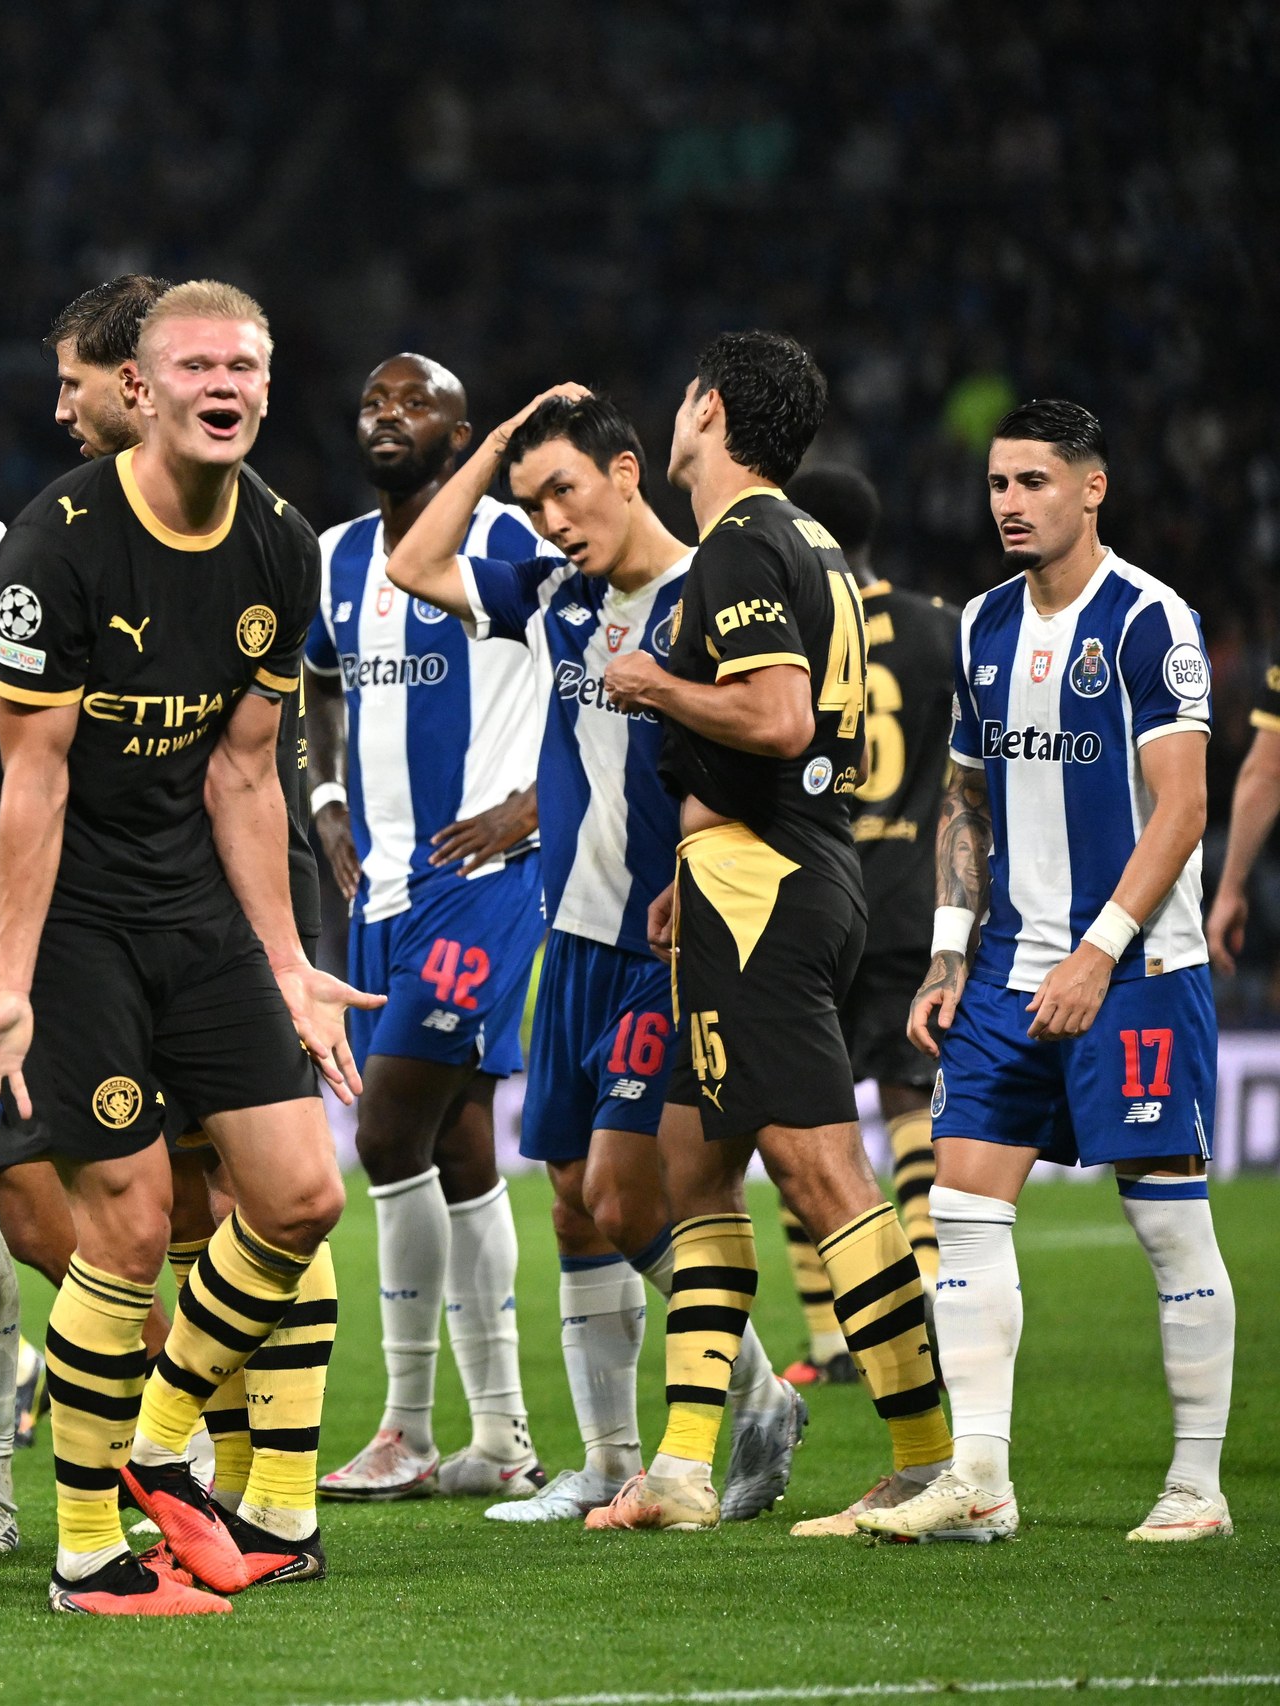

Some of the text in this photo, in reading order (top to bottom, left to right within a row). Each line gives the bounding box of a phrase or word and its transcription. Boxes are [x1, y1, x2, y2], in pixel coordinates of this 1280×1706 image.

[339, 653, 449, 692] Betano
[1171, 659, 1202, 672] SUPER
[1175, 671, 1204, 685] BOCK
[982, 719, 1102, 764] Betano
[421, 938, 489, 1010] 42
[607, 1010, 670, 1077] 16
[690, 1010, 727, 1080] 45
[1120, 1028, 1174, 1097] 17
